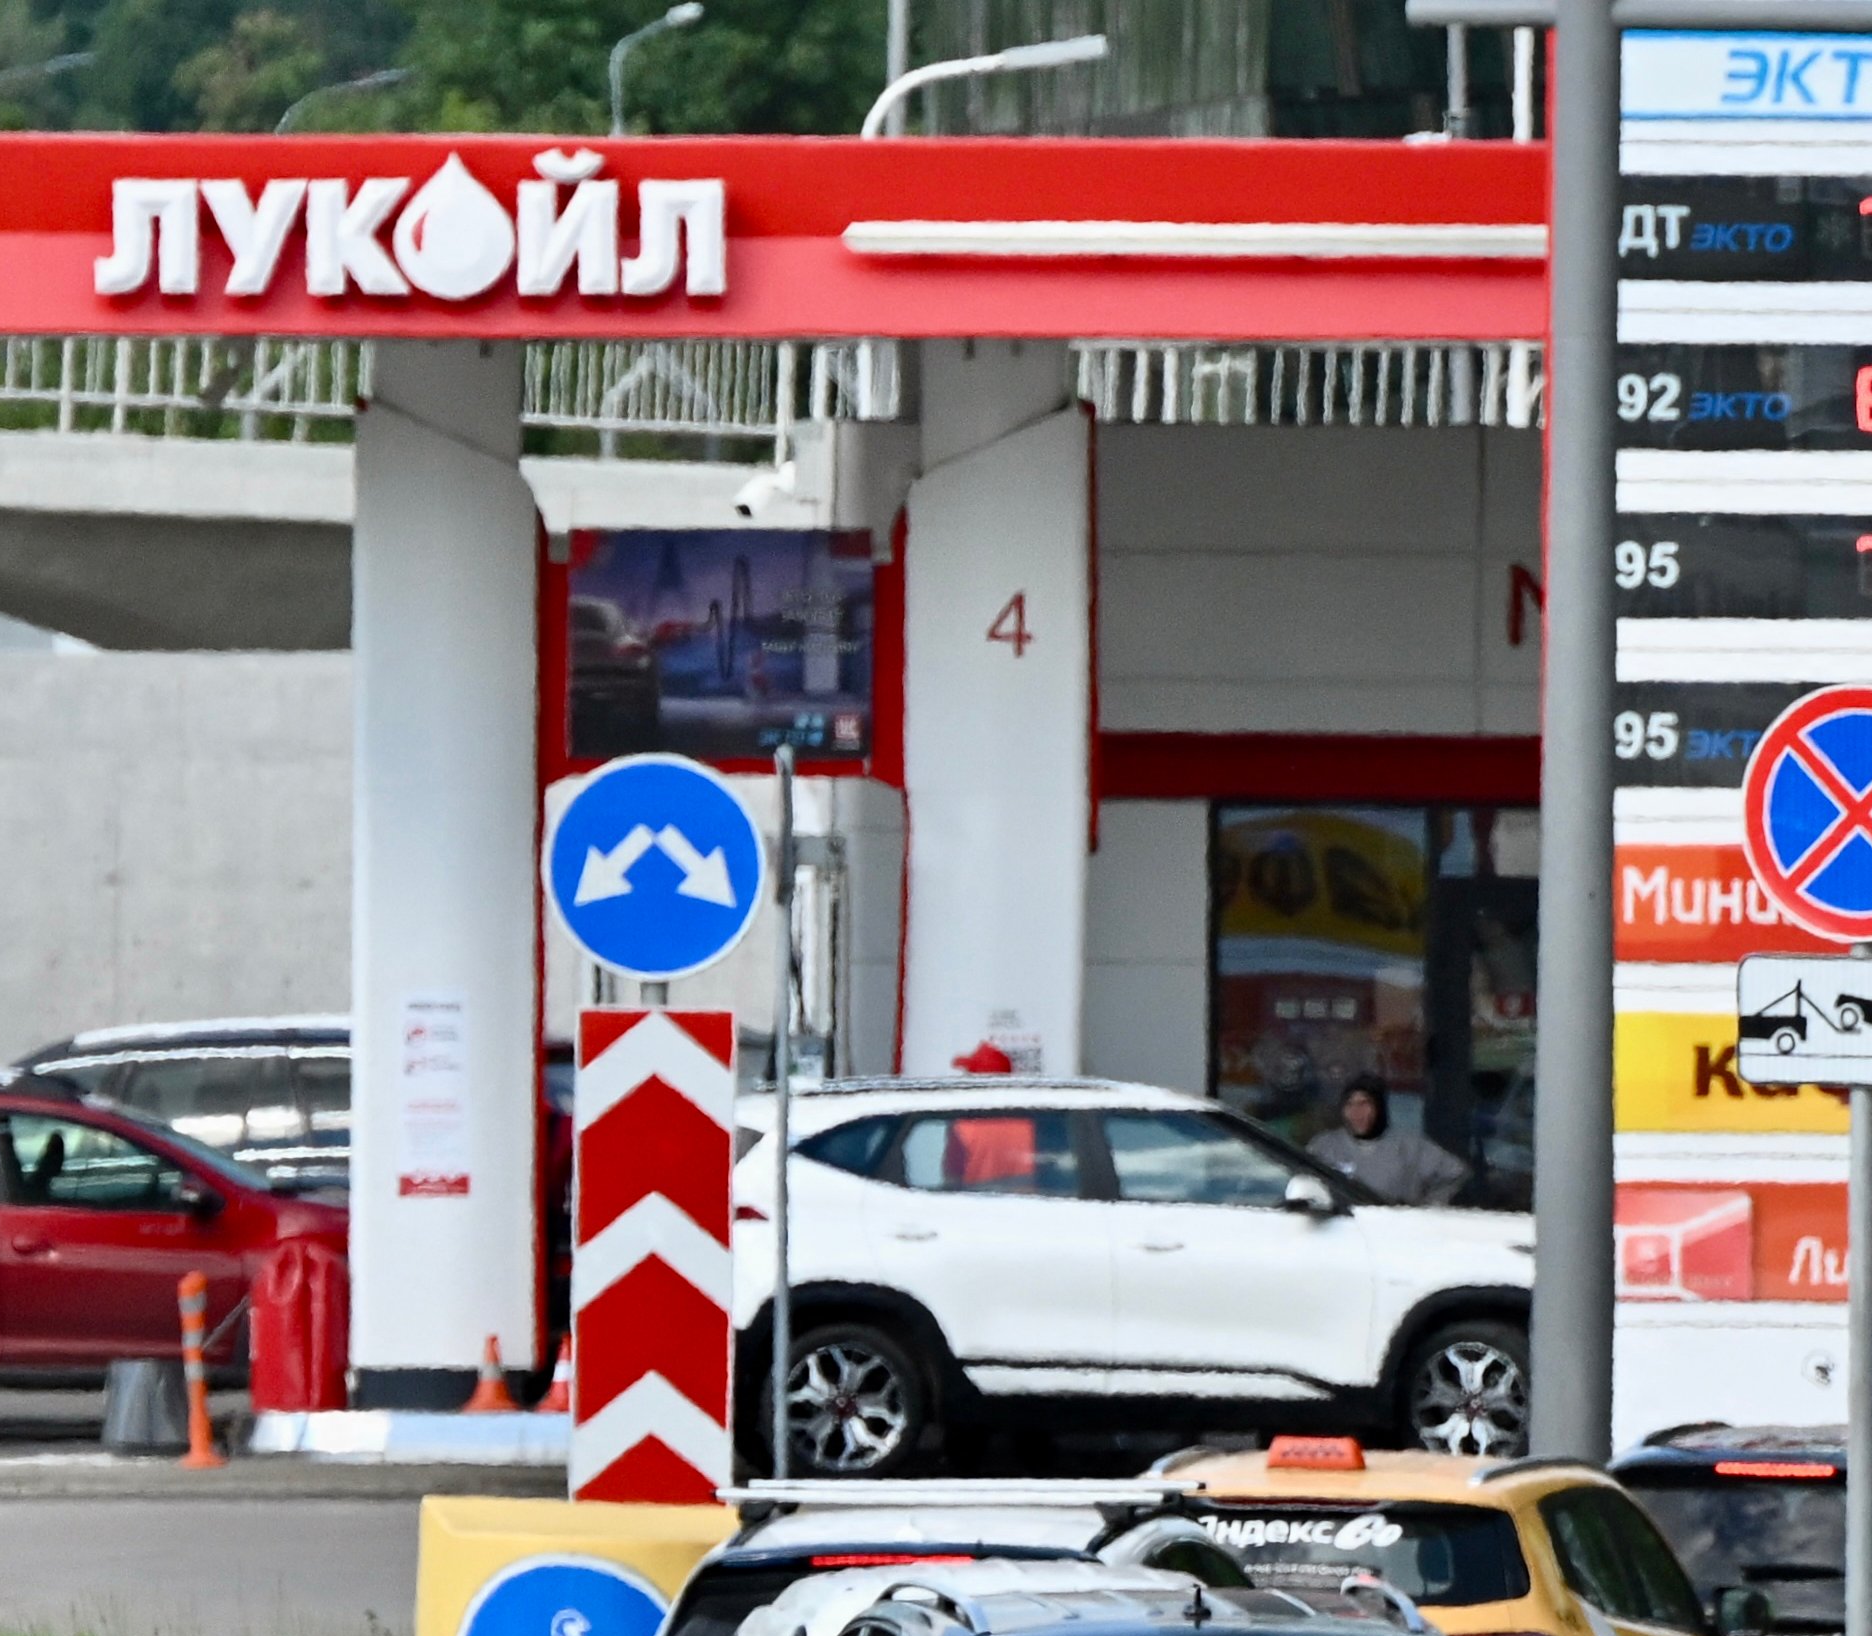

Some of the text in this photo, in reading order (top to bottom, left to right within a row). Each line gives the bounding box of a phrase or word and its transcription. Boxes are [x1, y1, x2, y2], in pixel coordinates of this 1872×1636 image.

[94, 148, 726, 300] ЛУКОЙЛ
[1619, 204, 1690, 255] ДТ
[1690, 223, 1794, 253] ЭКТО
[1617, 375, 1680, 422] 92
[1688, 394, 1792, 422] ЭКТО
[1616, 543, 1679, 589] 95
[986, 589, 1033, 658] 4
[1614, 711, 1678, 759] 95
[1685, 729, 1764, 759] ЭКТ
